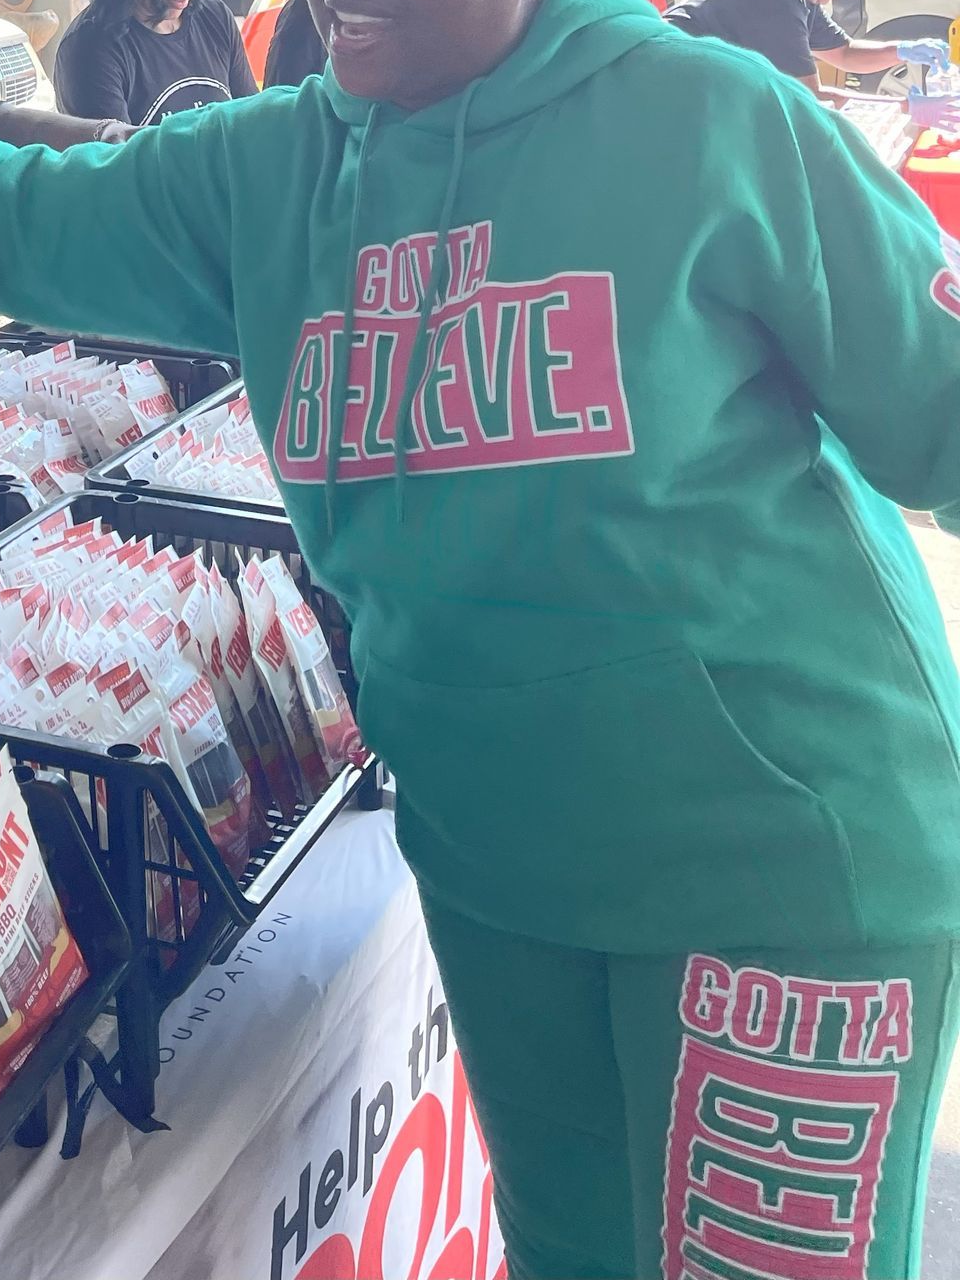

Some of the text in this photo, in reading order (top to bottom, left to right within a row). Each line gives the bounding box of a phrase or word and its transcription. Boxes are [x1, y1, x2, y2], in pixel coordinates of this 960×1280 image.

[355, 219, 492, 315] GOTTA
[4, 927, 16, 947] MINI
[24, 872, 39, 903] STICKS
[158, 910, 293, 1064] OUNDATION
[679, 953, 913, 1065] GOTTA
[271, 1080, 394, 1280] Help
